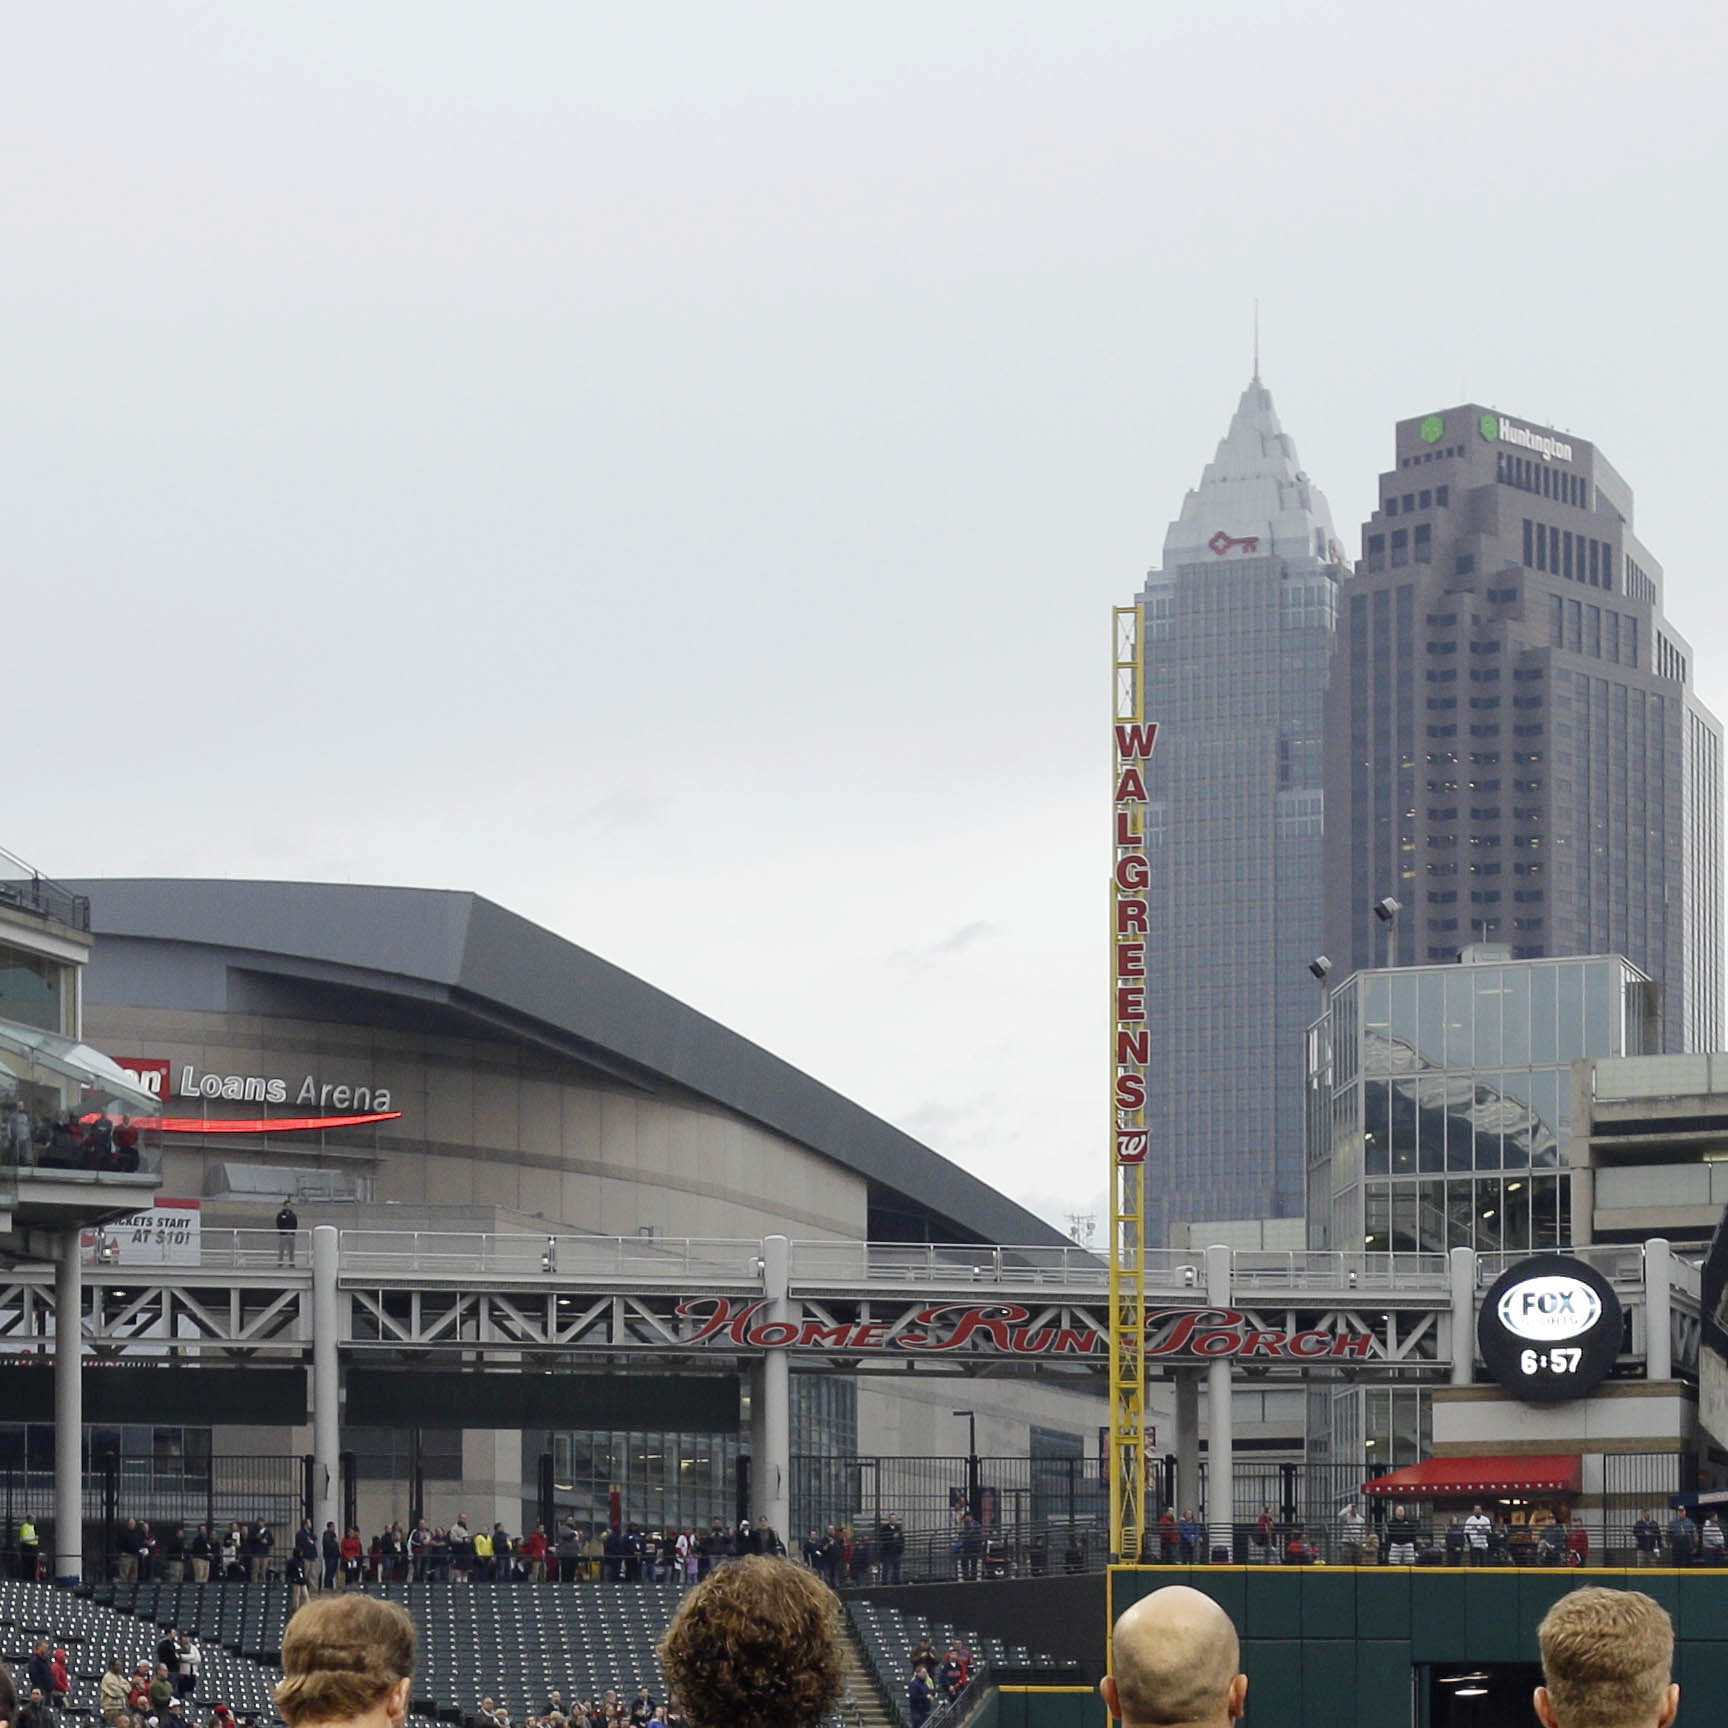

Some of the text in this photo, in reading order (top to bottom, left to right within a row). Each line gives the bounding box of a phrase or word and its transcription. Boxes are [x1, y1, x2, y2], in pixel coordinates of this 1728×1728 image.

[1498, 417, 1572, 462] Huntington
[1115, 722, 1160, 1111] WALGREENS
[180, 1065, 287, 1103] Loans
[296, 1074, 392, 1113] Arena
[110, 1215, 192, 1229] ICKETS START
[131, 1228, 152, 1244] AT
[1522, 1291, 1576, 1316] FOX
[1520, 1347, 1583, 1376] 6:57
